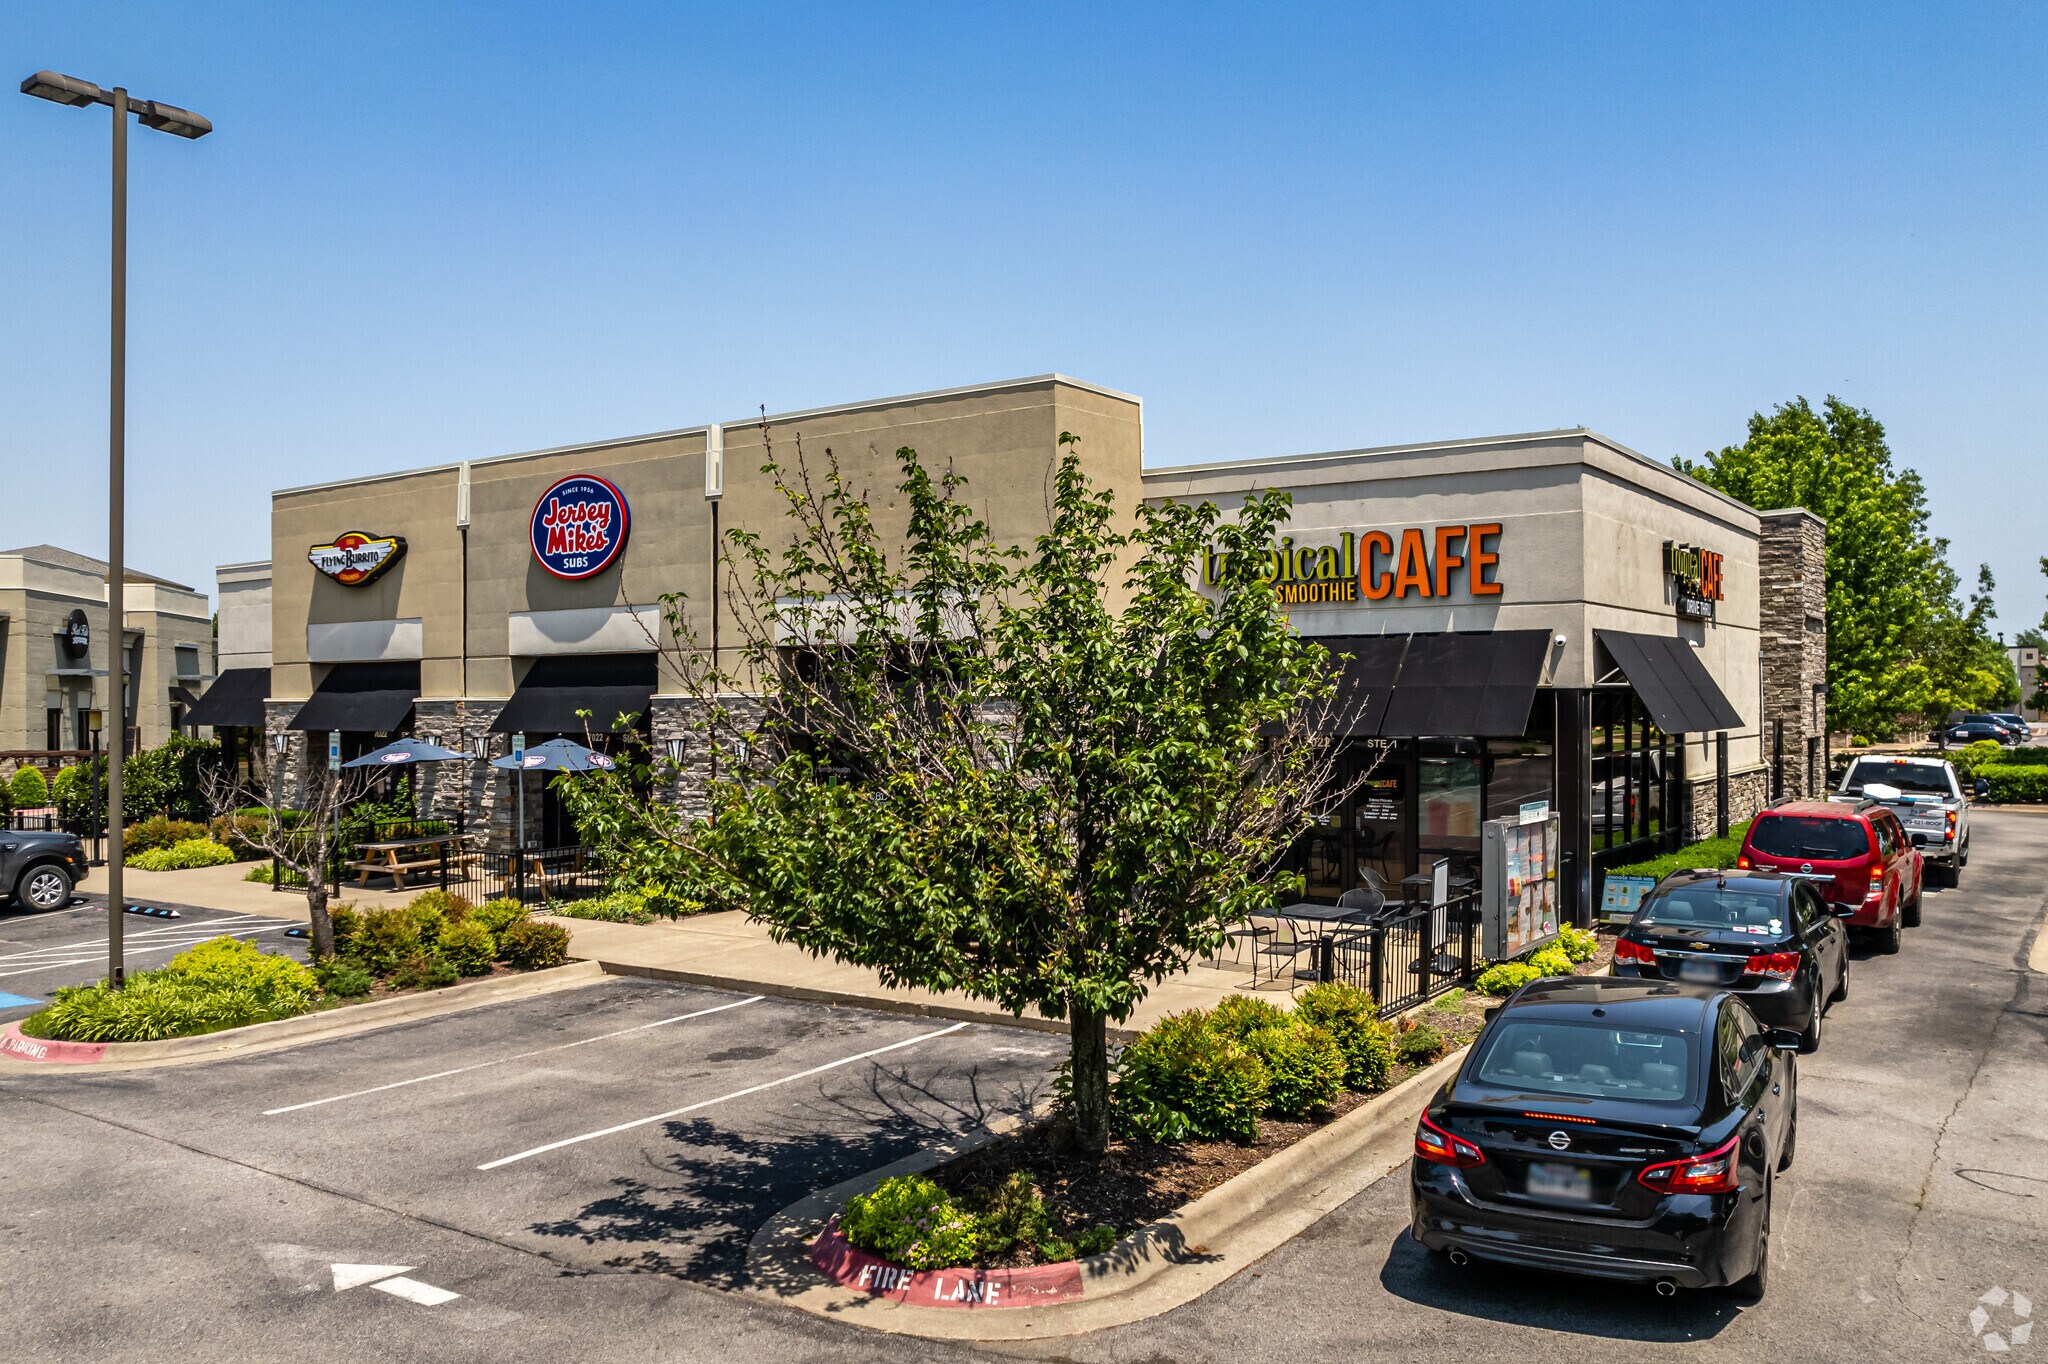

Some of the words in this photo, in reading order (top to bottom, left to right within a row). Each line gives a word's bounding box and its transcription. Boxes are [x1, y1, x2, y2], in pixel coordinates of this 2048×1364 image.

[562, 486, 578, 496] SINCE
[580, 486, 595, 494] 1956
[542, 497, 612, 530] Jersey
[545, 524, 610, 556] Mike's
[321, 553, 346, 567] FLYING
[346, 549, 379, 568] BURRITO
[563, 556, 589, 569] SUBS
[1203, 531, 1356, 588] trpical
[1359, 522, 1504, 601] CAFE
[1701, 548, 1724, 601] CAFE
[1274, 581, 1356, 604] SMOOTHIE
[1367, 738, 1387, 749] STE
[1383, 779, 1398, 788] CAFE
[7, 1038, 48, 1059] PARKING
[857, 1264, 915, 1291] FIRE
[934, 1276, 1002, 1306] LANE
